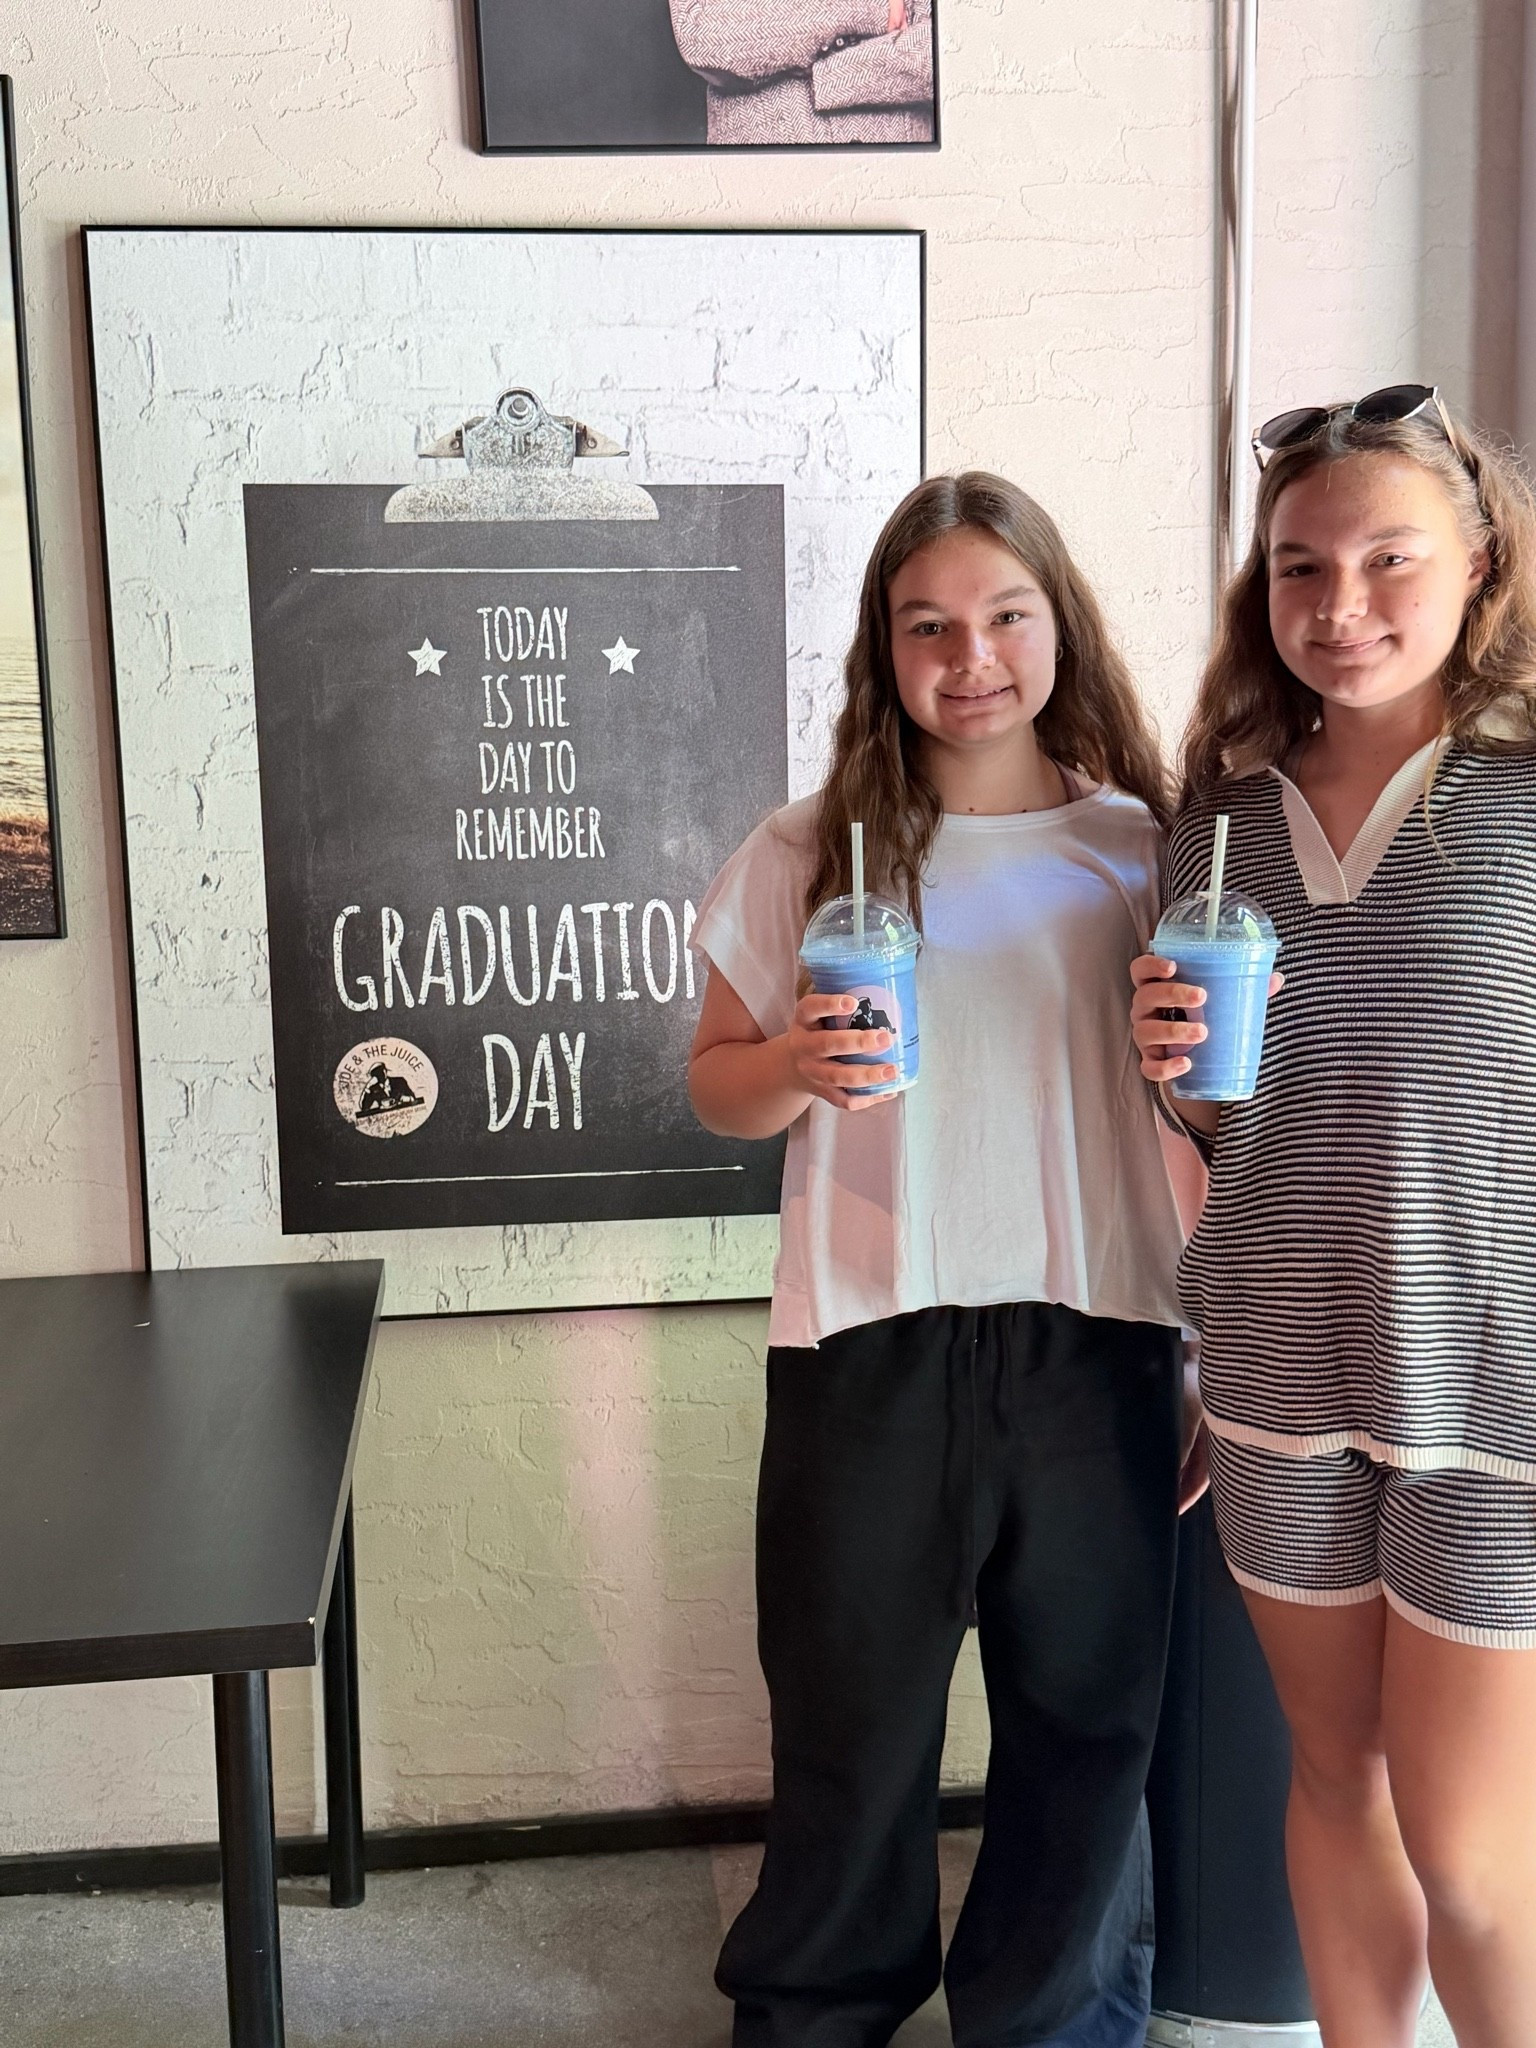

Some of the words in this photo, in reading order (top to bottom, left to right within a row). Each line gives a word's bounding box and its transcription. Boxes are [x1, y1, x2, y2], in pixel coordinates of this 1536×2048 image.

[477, 606, 567, 662] TODAY
[482, 674, 512, 728] IS
[520, 674, 569, 727] THE
[479, 742, 531, 794] DAY
[540, 740, 575, 794] TO
[456, 806, 605, 860] REMEMBER
[339, 1063, 356, 1090] JOE
[352, 1055, 363, 1066] &
[363, 1044, 388, 1058] THE
[390, 1047, 423, 1072] JUICE
[483, 1032, 585, 1131] DAY
